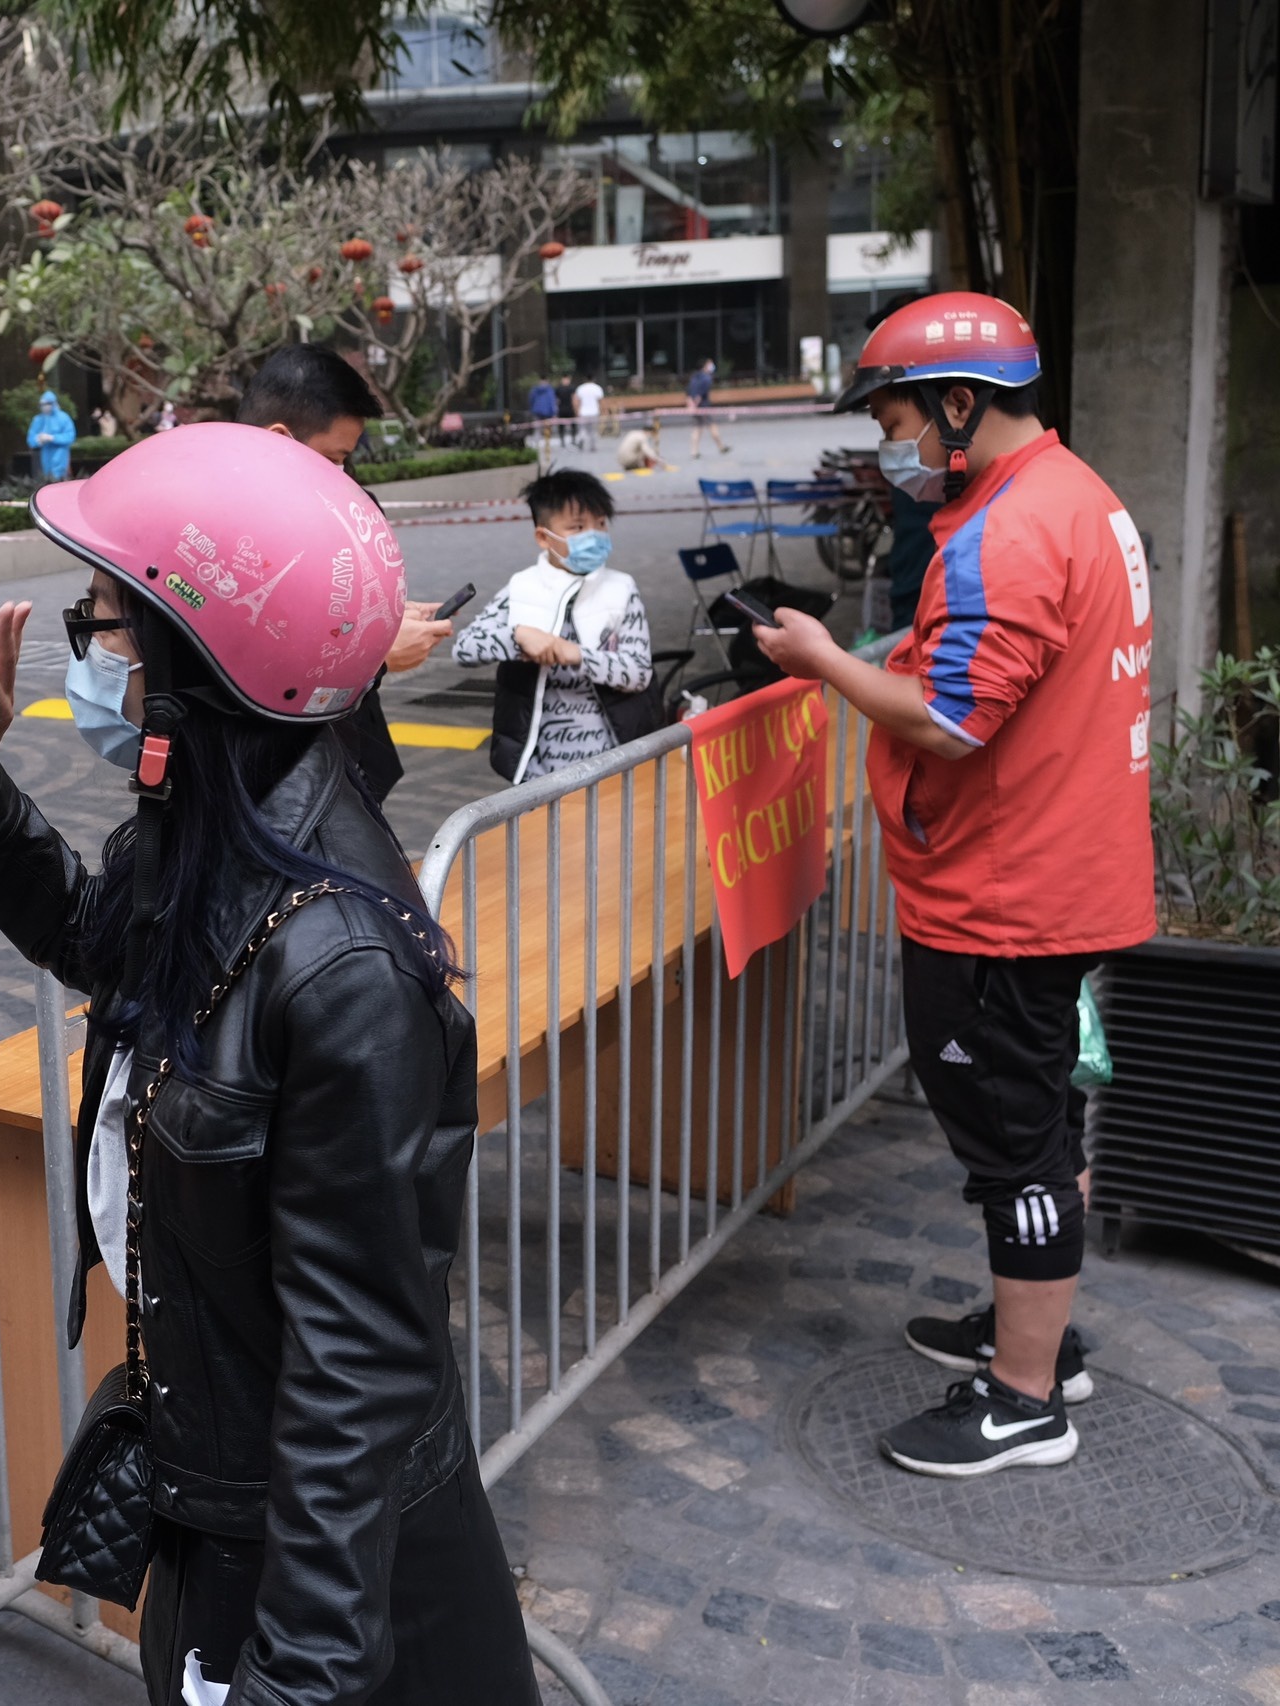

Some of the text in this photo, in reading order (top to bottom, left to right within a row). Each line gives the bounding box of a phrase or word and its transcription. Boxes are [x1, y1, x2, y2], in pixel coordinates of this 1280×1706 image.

[180, 581, 206, 605] HITA
[699, 691, 820, 800] KHU VỰC
[717, 774, 818, 889] CÁCH LY
